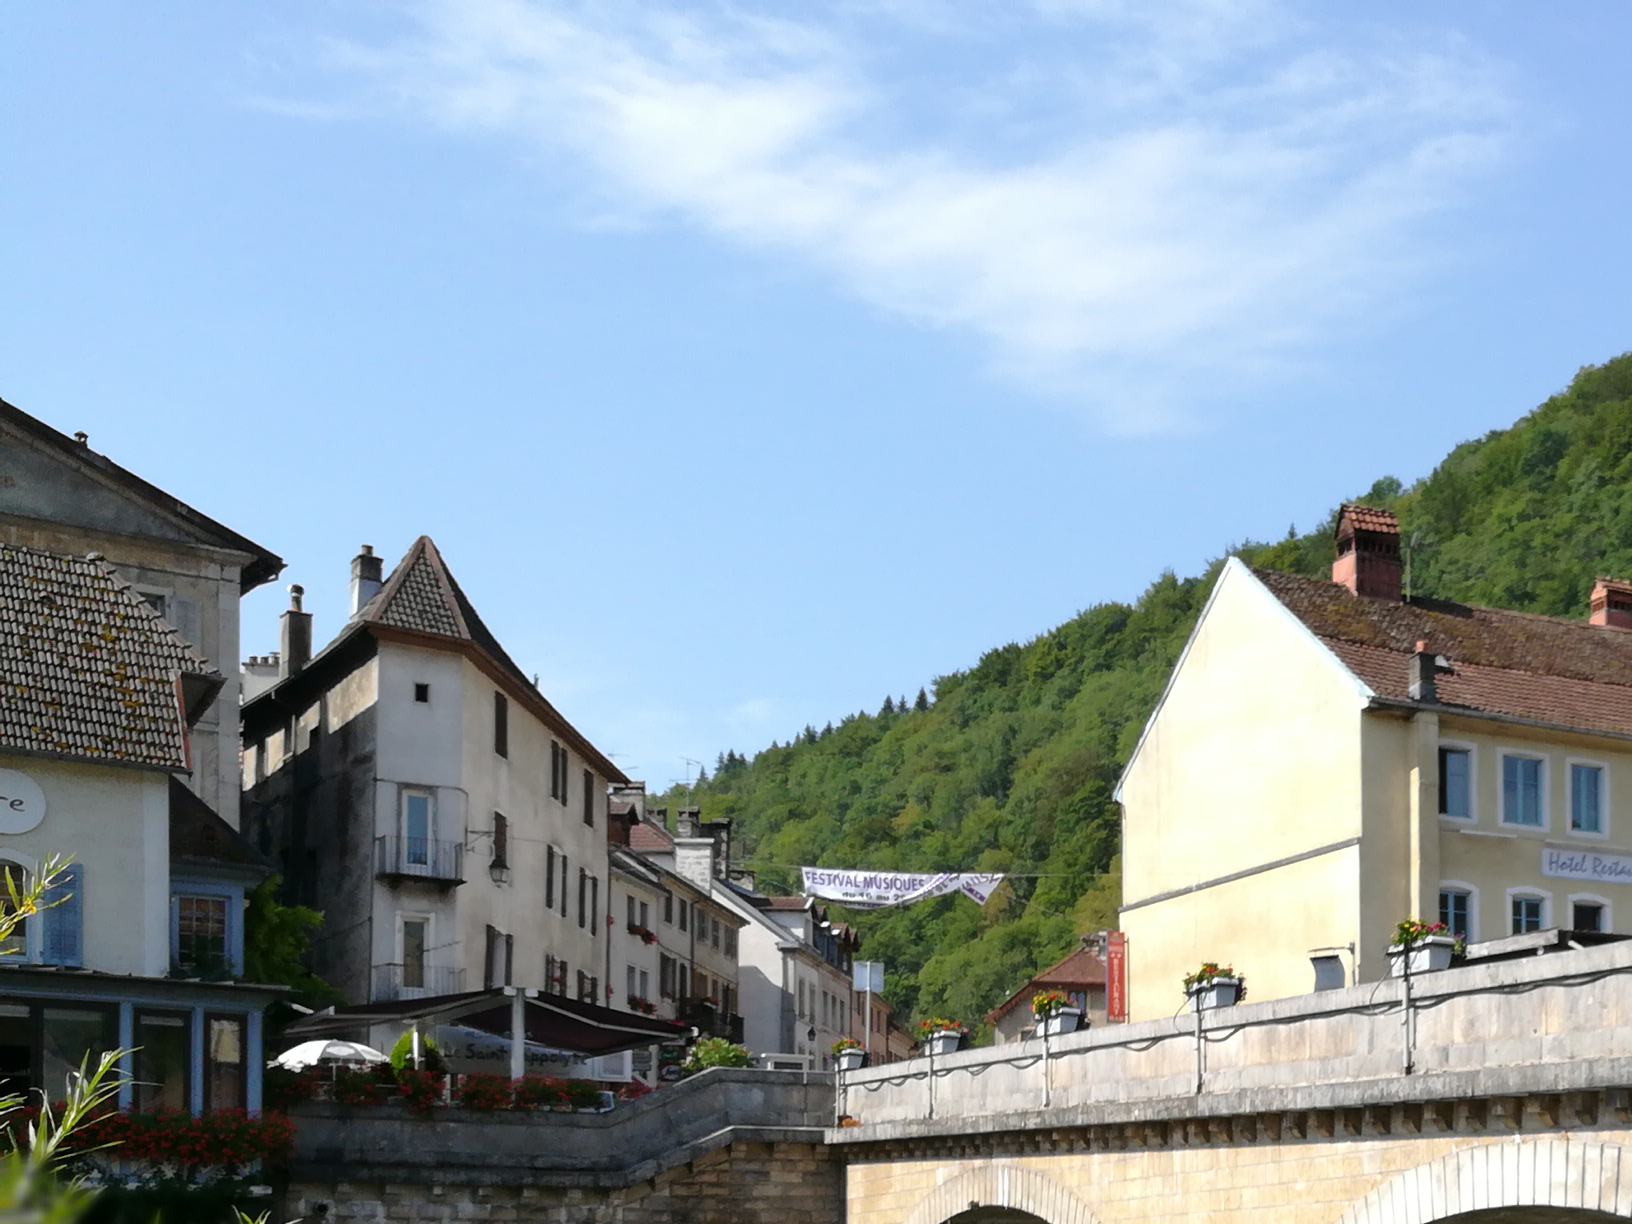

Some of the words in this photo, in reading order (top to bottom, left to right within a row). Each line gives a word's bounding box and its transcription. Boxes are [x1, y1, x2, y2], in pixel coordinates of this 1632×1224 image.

[805, 871, 860, 889] FESTIVAL
[862, 877, 925, 892] MUSIQUES
[465, 1042, 508, 1061] Saint
